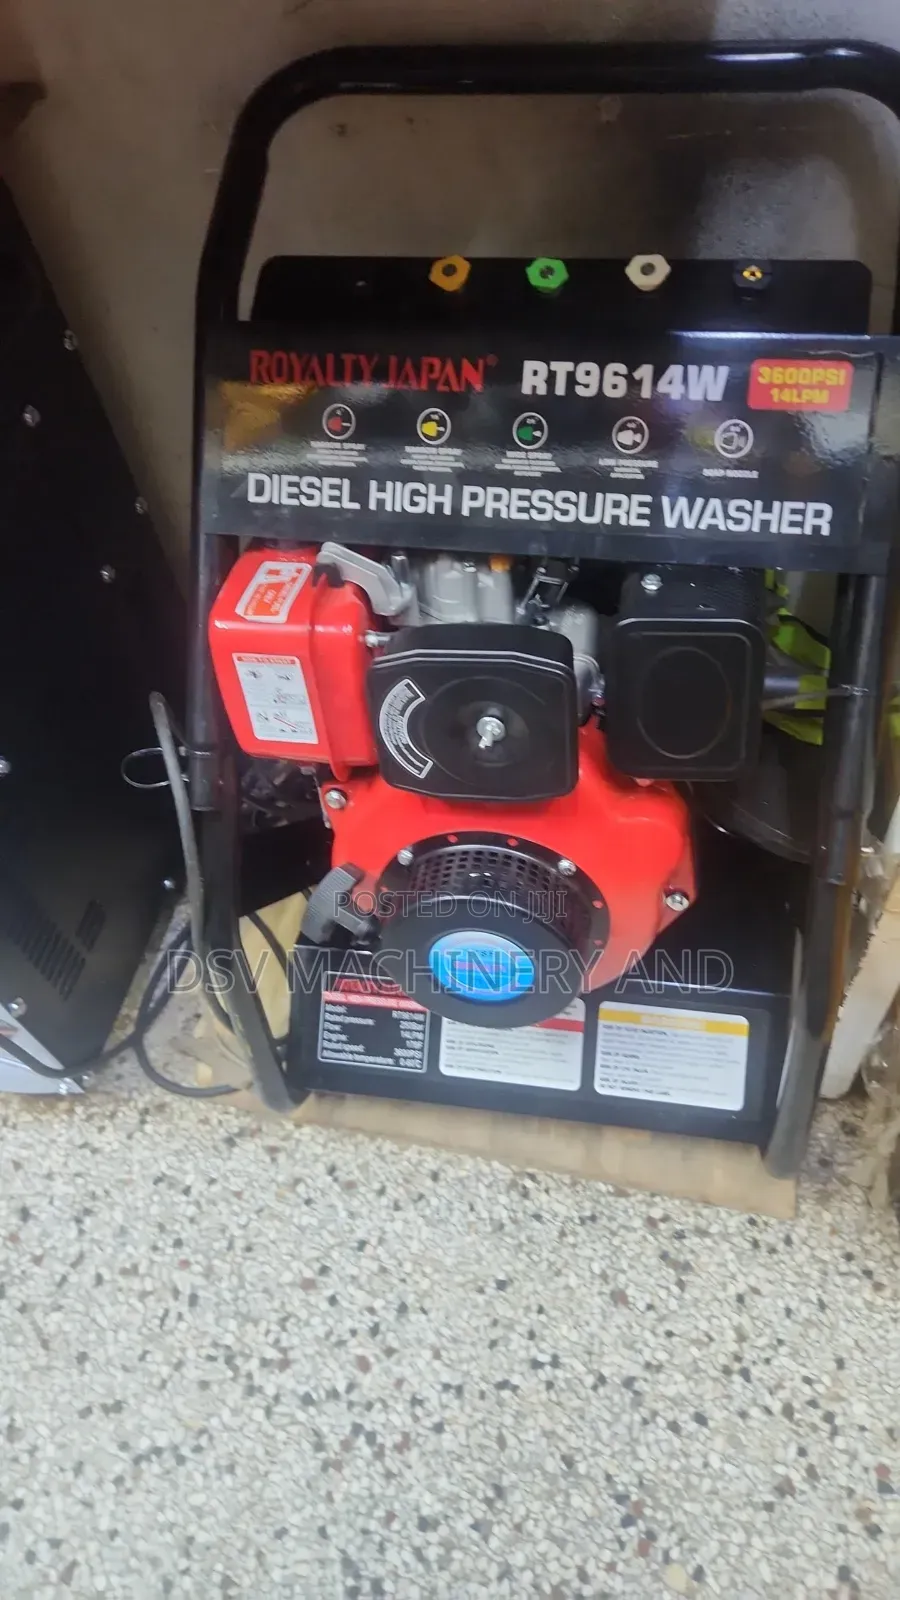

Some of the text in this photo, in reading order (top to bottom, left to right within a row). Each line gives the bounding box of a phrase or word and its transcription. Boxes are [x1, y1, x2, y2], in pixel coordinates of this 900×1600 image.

[250, 350, 379, 388] ROYALTY
[520, 360, 730, 402] RT9614W
[757, 366, 848, 387] 3600PSI
[769, 387, 830, 404] 14LPM
[247, 472, 834, 537] DIESEL HIGH PRESSURE WASHER
